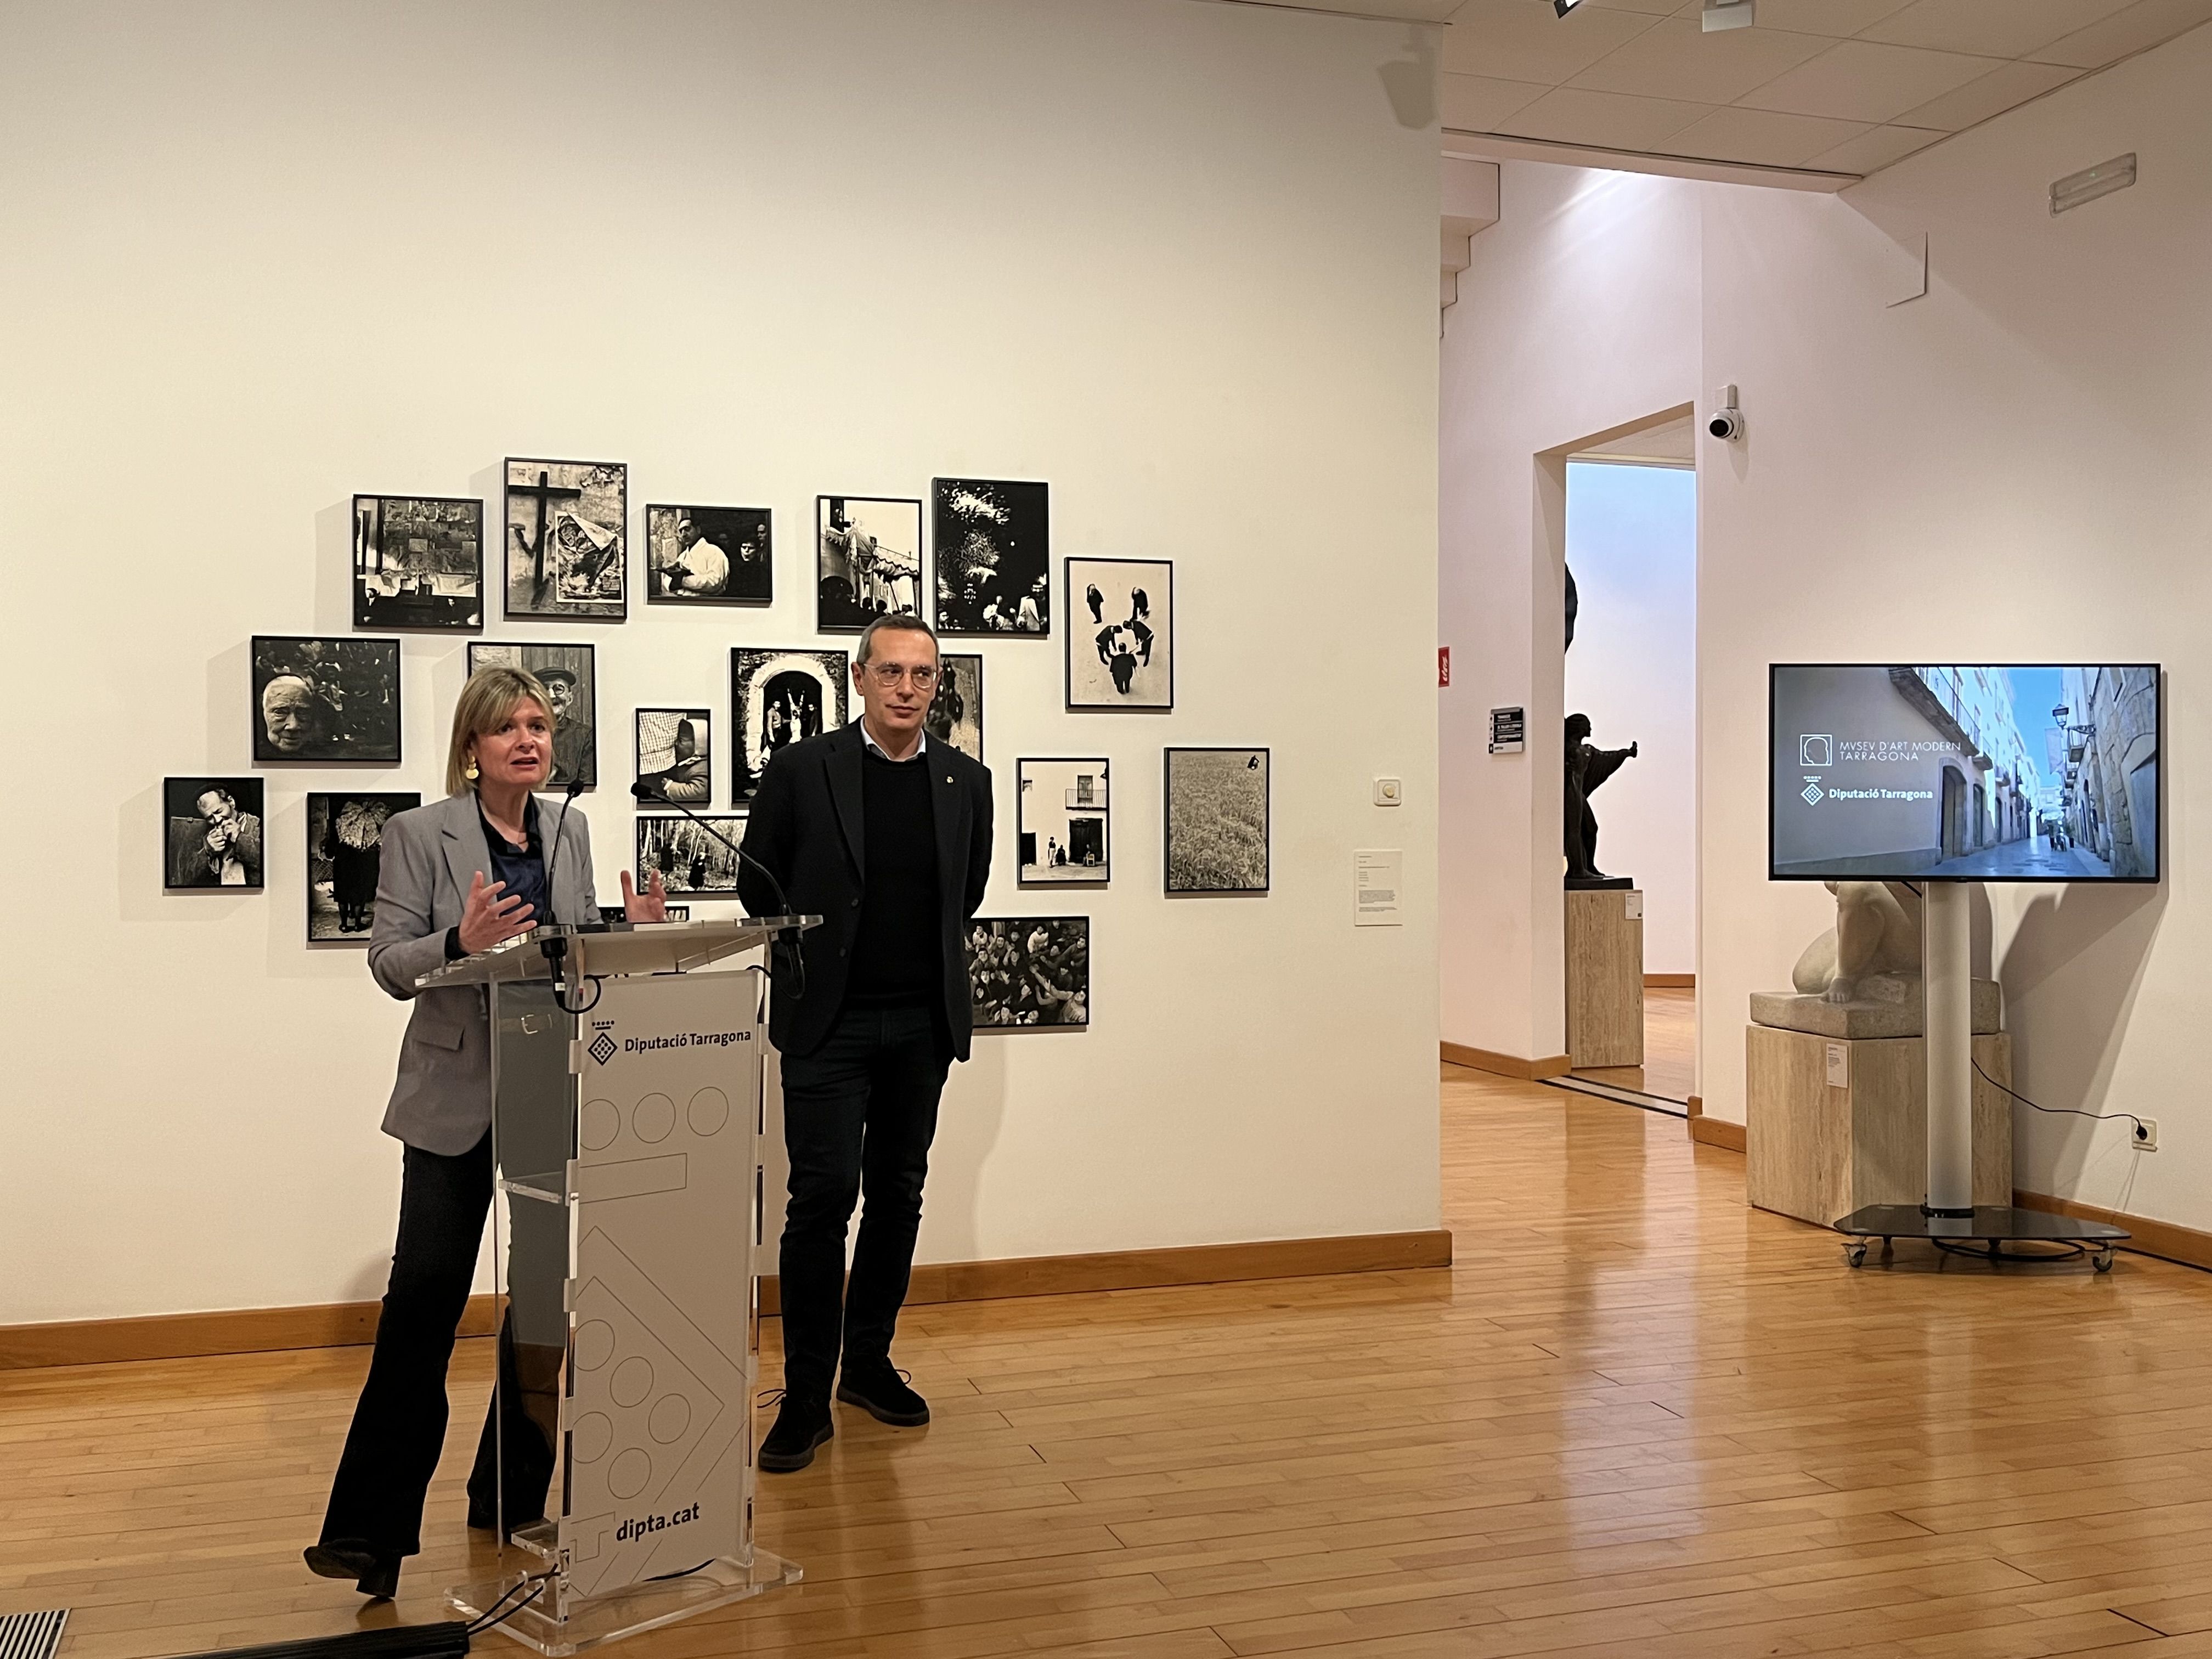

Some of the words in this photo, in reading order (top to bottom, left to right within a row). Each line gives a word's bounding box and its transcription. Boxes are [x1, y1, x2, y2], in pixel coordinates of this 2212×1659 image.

[1839, 742, 1875, 751] MVSEV
[1880, 741, 1908, 751] D'ART
[1912, 742, 1961, 751] MODERN
[1840, 752, 1919, 761] TARRAGONA
[1829, 788, 1879, 800] Diputació
[1881, 789, 1933, 802] Tarragona
[625, 1034, 687, 1054] Diputació
[690, 1031, 751, 1047] Tarragona
[616, 1502, 699, 1542] dipta.cat
